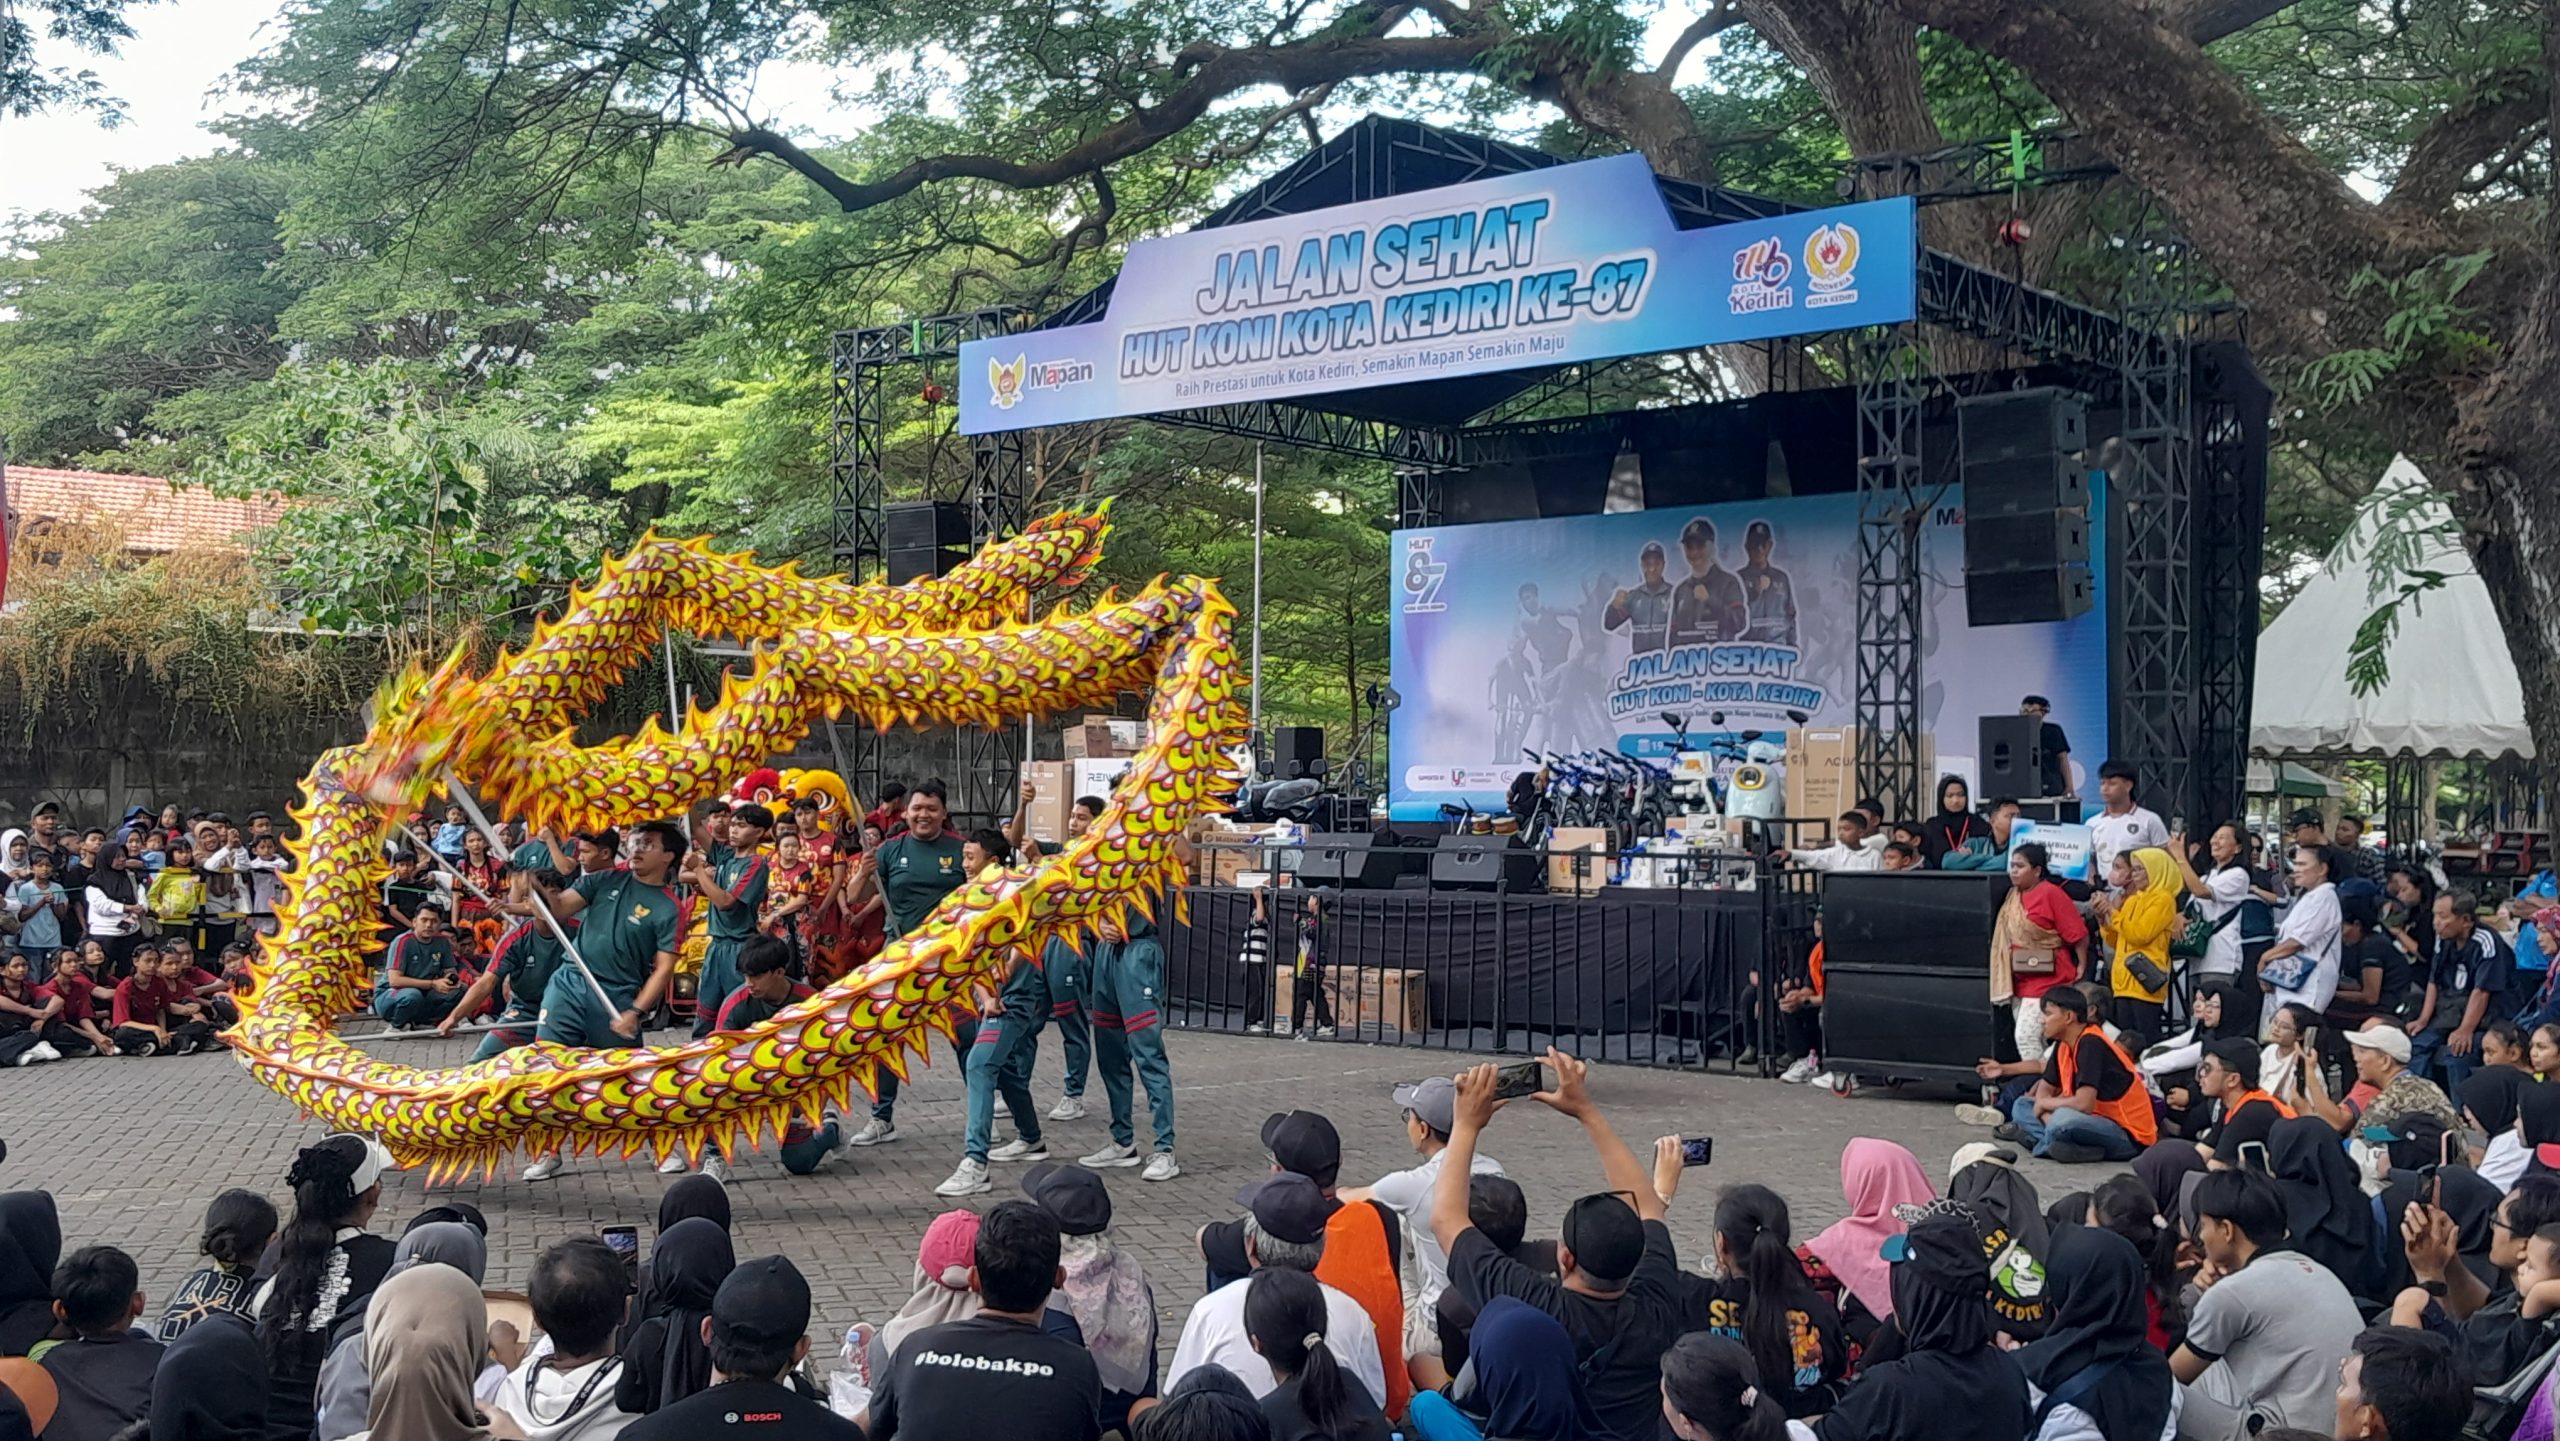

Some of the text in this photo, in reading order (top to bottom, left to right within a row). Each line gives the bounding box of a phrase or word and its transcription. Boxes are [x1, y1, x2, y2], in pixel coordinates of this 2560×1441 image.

[1198, 198, 1550, 315] JALAN SEHAT
[1730, 289, 1790, 313] Kediri
[1733, 284, 1762, 294] KOTA
[1120, 257, 1649, 379] HUT KONI KOTA KEDIRI KE-87
[1030, 363, 1093, 390] Mapan
[1175, 335, 1565, 397] Raih Prestasi untuk Kota Kediri, Semakin Mapan Semakin Maju
[1408, 538, 1434, 550] HUT
[1404, 551, 1447, 605] 87
[1617, 645, 1798, 691] JALAN SEHAT
[1611, 690, 1648, 716] HUT
[1649, 683, 1692, 707] KONI
[1704, 681, 1753, 702] KOTA
[1756, 682, 1821, 711] KEDIRI
[914, 1350, 1055, 1377] #bolobakpo
[743, 1412, 783, 1423] BOSCH
